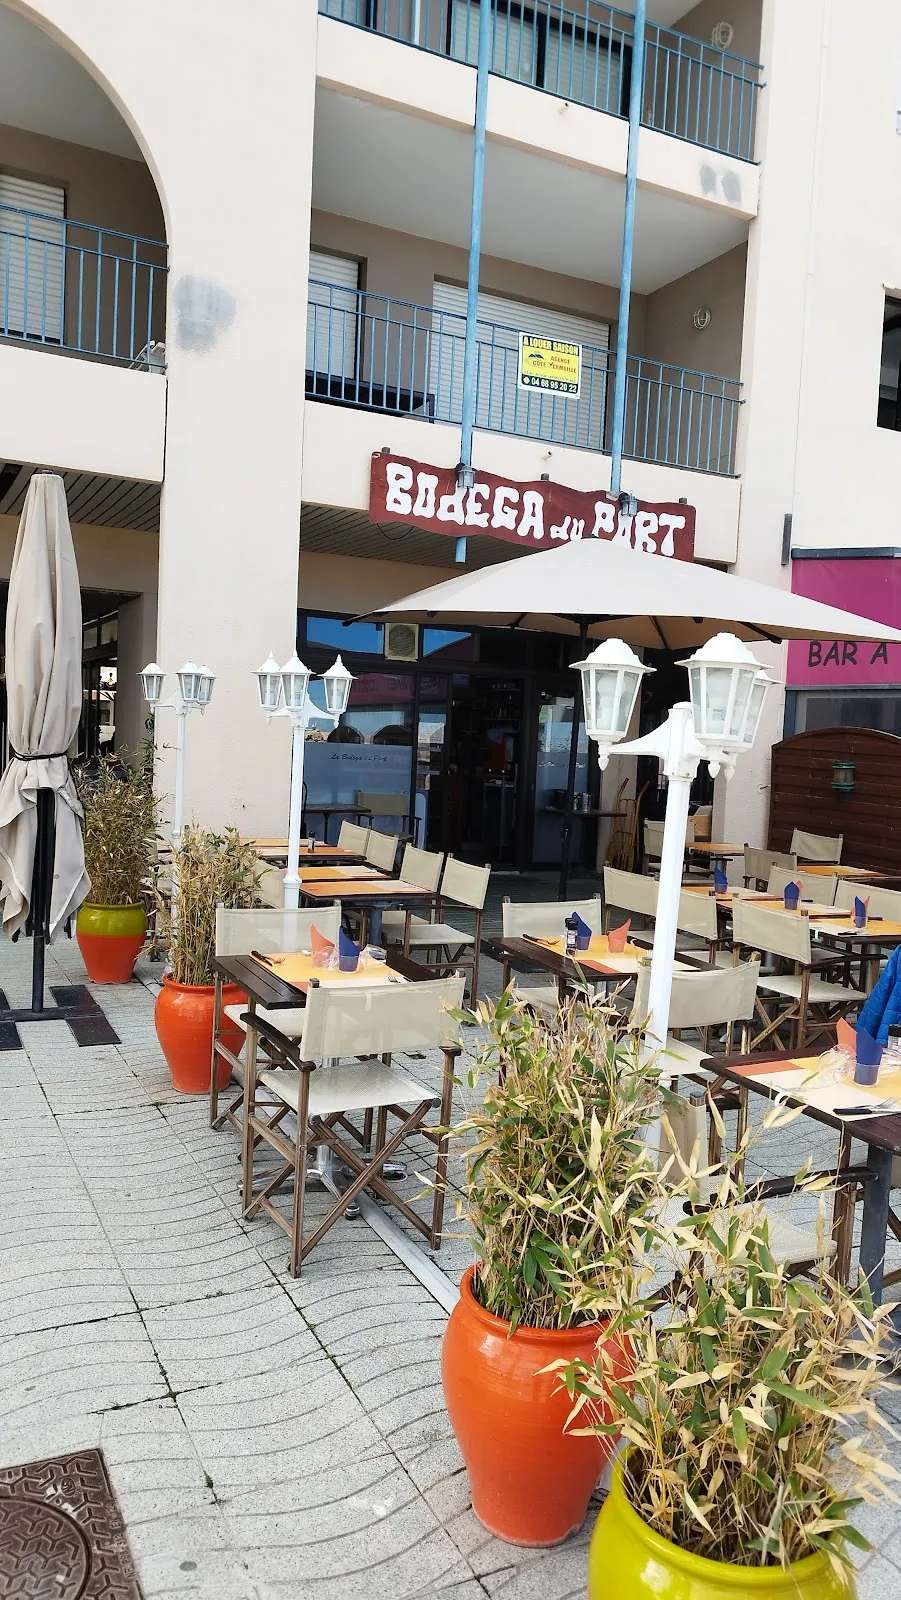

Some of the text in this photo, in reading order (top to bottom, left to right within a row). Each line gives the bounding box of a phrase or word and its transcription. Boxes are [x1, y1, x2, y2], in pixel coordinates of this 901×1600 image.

[530, 337, 552, 350] LOUER
[553, 342, 578, 355] SAISON
[531, 377, 577, 393] 04 68 95 20 22
[550, 515, 585, 540] du
[809, 640, 888, 667] BAR A
